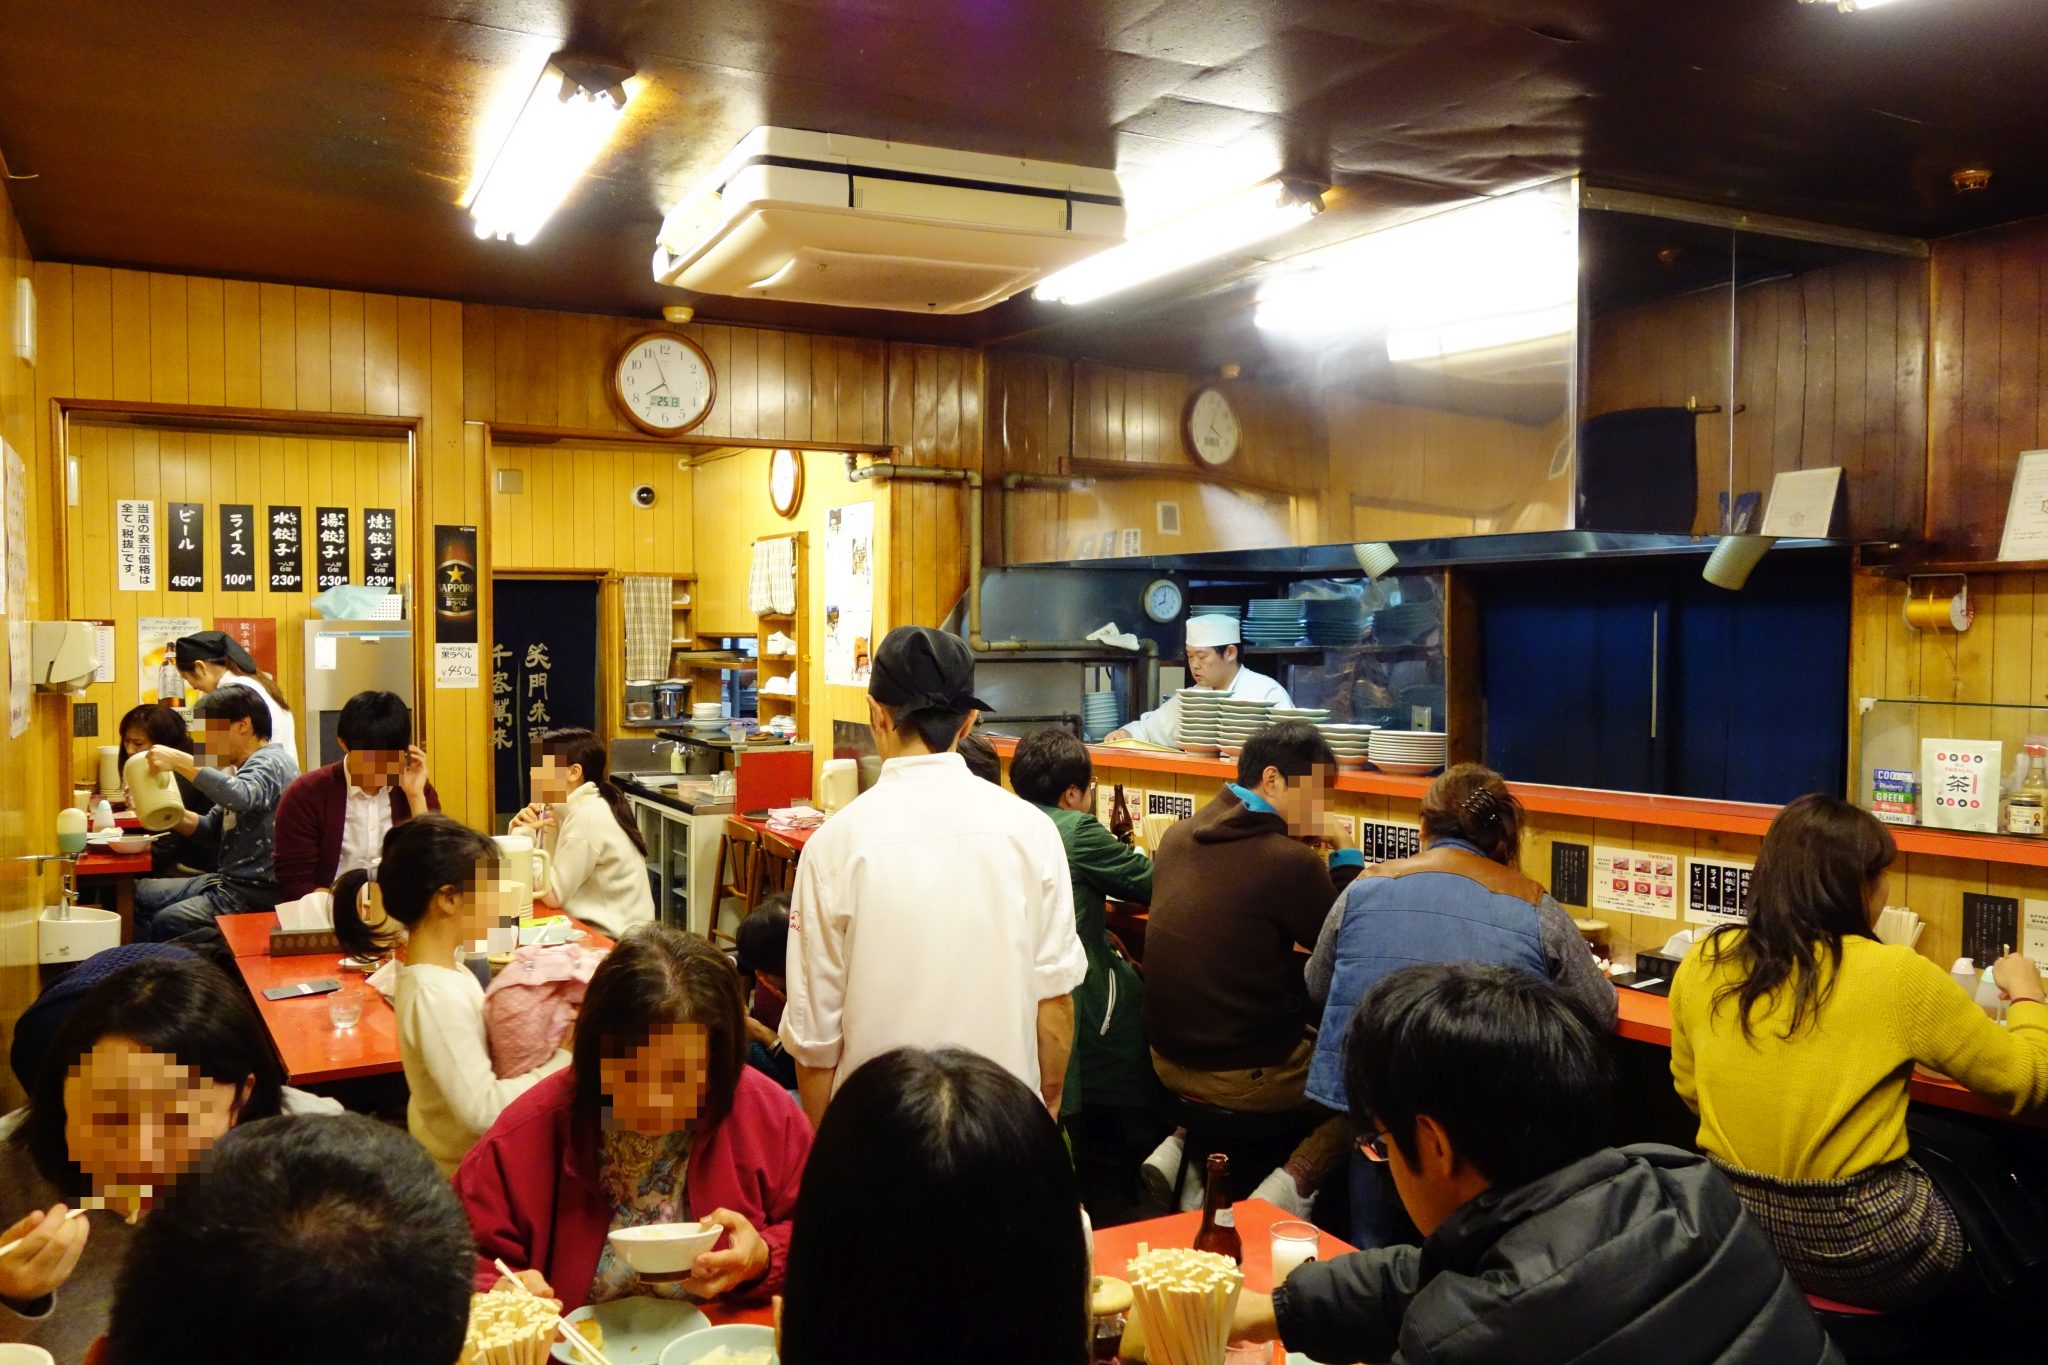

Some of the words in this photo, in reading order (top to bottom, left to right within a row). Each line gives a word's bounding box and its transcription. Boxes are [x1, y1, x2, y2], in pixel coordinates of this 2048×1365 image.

[121, 503, 135, 577] 全て「税抜」です。
[178, 509, 195, 550] ビール
[229, 513, 246, 556] ライス
[272, 511, 294, 557] 水餃子
[137, 503, 151, 585] 当店の表示価格は
[271, 574, 301, 586] 230円
[319, 575, 348, 586] 230円
[366, 575, 394, 587] 230円
[1946, 774, 1970, 793] 茶
[1876, 792, 1904, 803] GREEN
[1694, 866, 1702, 887] ビール
[1710, 868, 1718, 890] ライス
